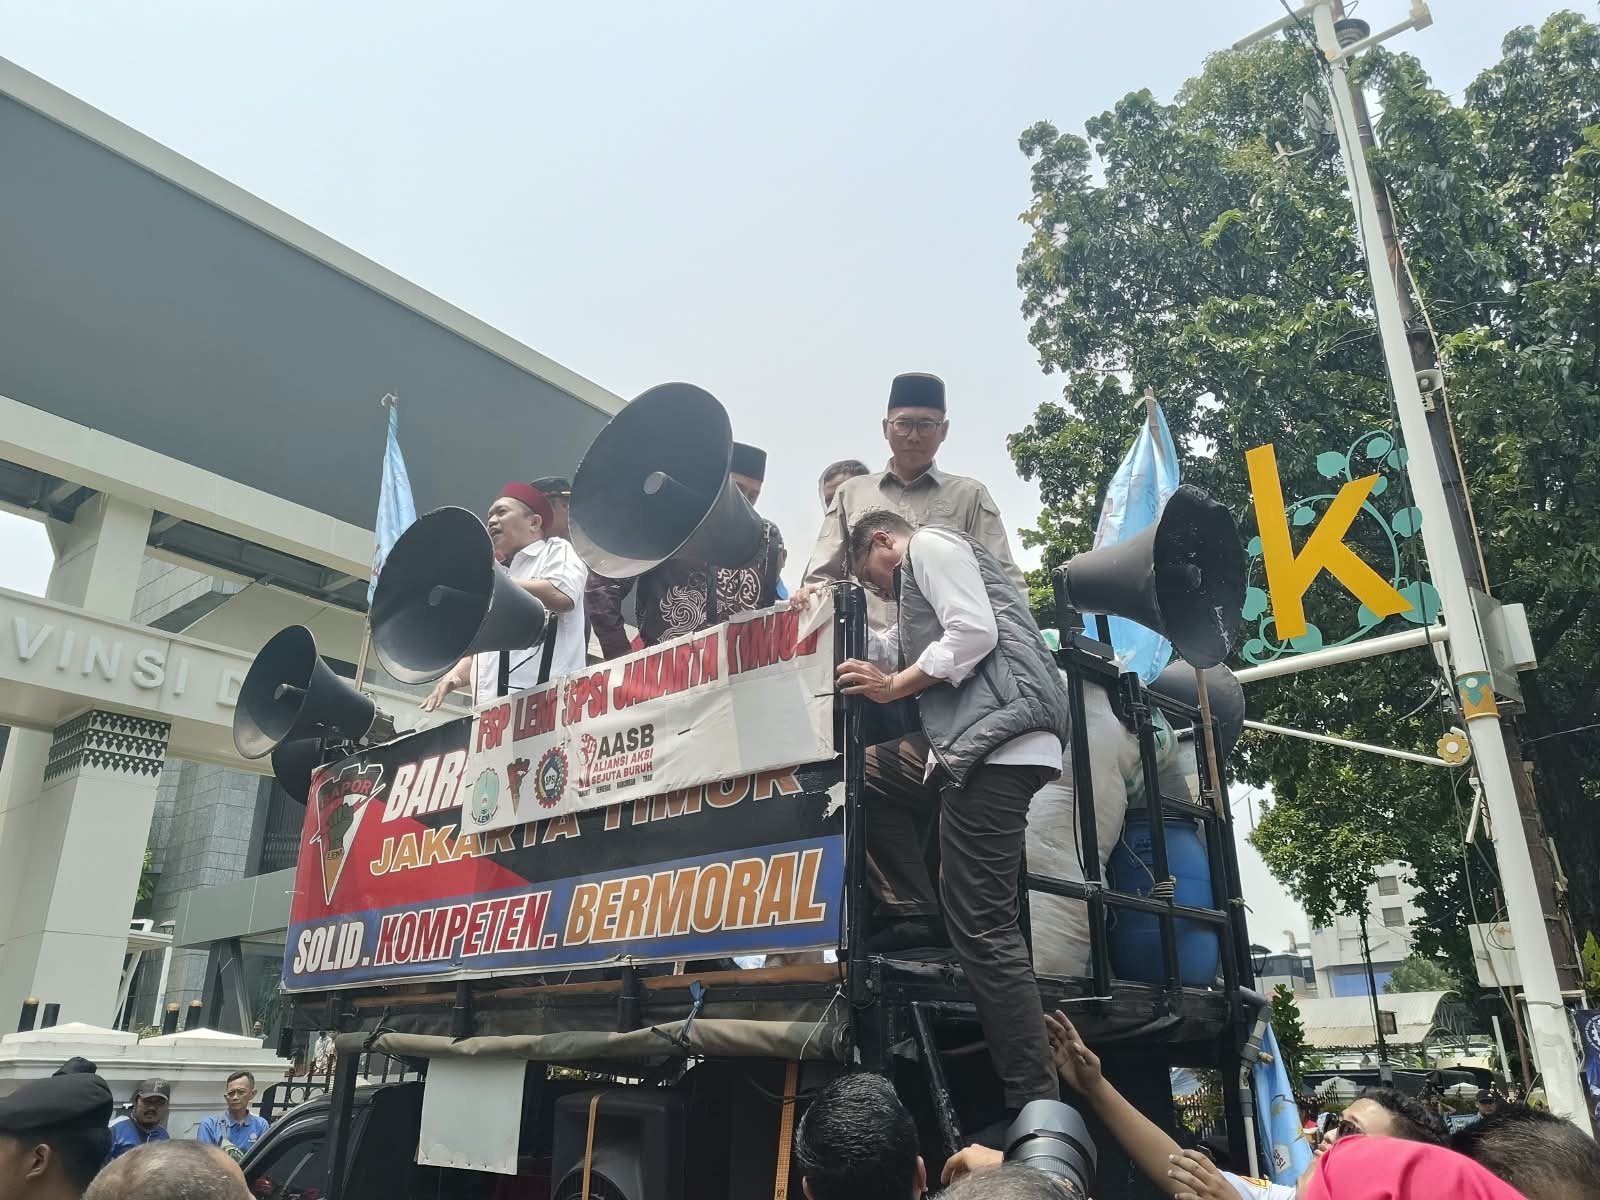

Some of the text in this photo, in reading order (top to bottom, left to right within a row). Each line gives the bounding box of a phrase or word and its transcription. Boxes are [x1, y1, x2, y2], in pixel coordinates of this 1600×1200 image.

[14, 616, 189, 696] VINSI
[477, 702, 512, 753] FSP
[513, 684, 558, 742] LEM
[562, 669, 611, 727] SPSI
[613, 632, 719, 710] JAKARTA
[593, 748, 654, 773] ALIANSI AKSI
[597, 723, 655, 760] AASB
[591, 762, 653, 785] SEJUTA BURUH
[477, 812, 491, 824] LEM
[369, 813, 581, 876] JAKARTA
[293, 848, 827, 974] SOLID. KOMPETEN. BERMORAL
